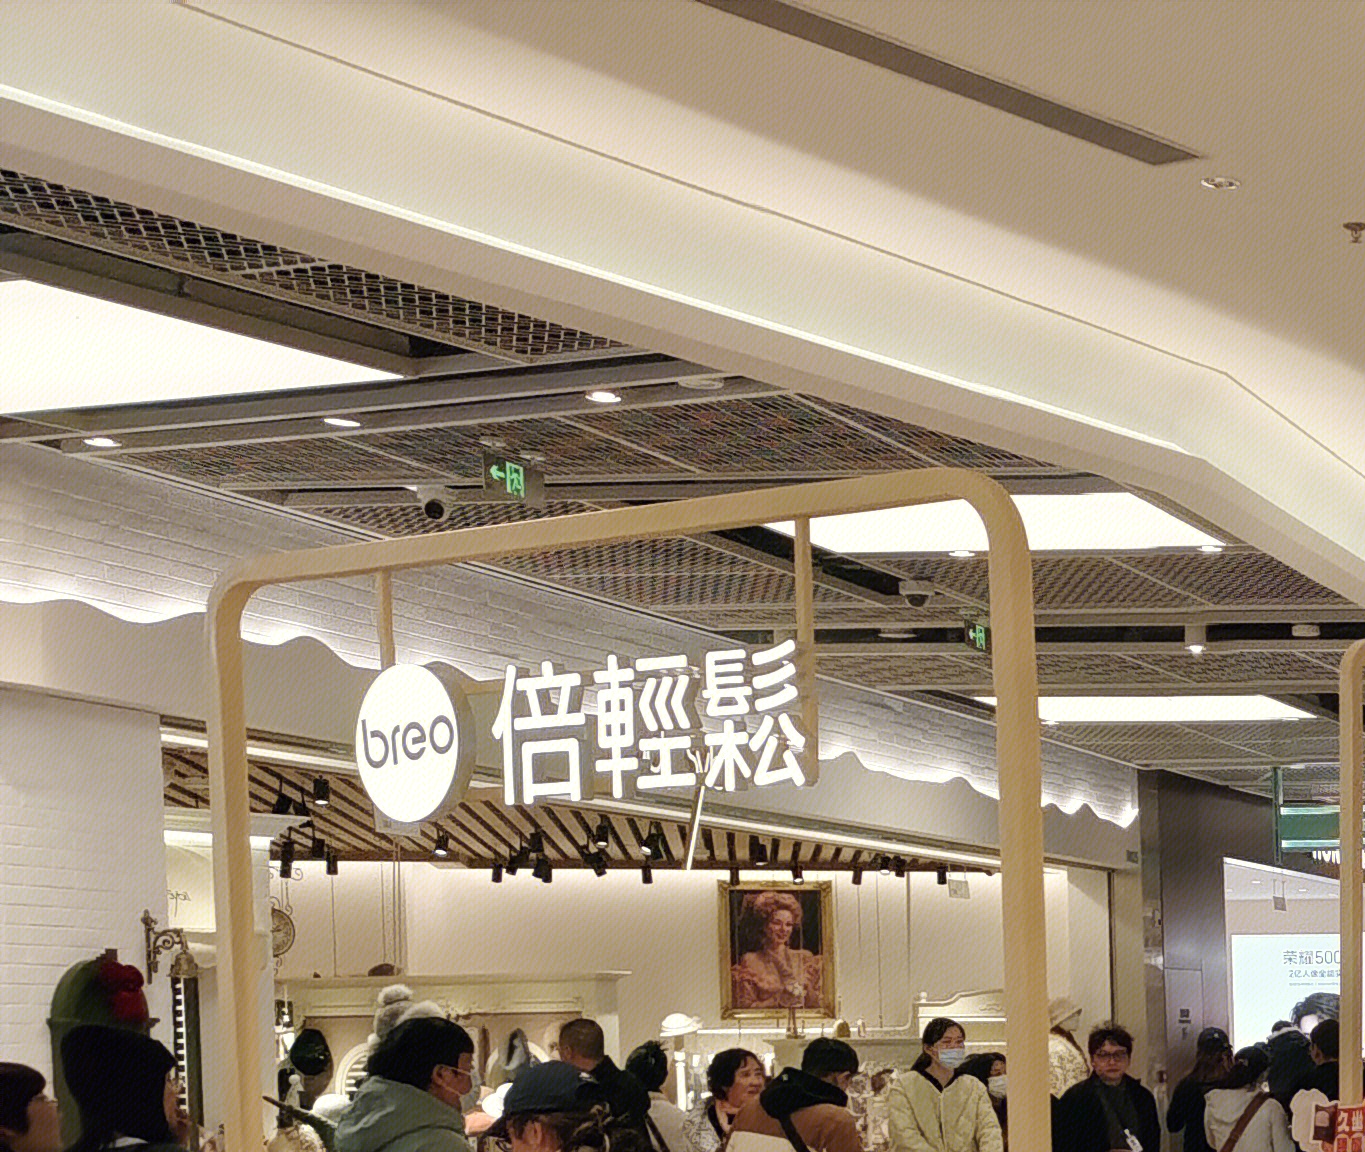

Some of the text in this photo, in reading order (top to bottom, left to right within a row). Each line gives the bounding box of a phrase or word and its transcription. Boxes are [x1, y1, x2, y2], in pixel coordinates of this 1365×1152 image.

[359, 714, 455, 769] breo
[491, 639, 806, 806] 倍輕鬆
